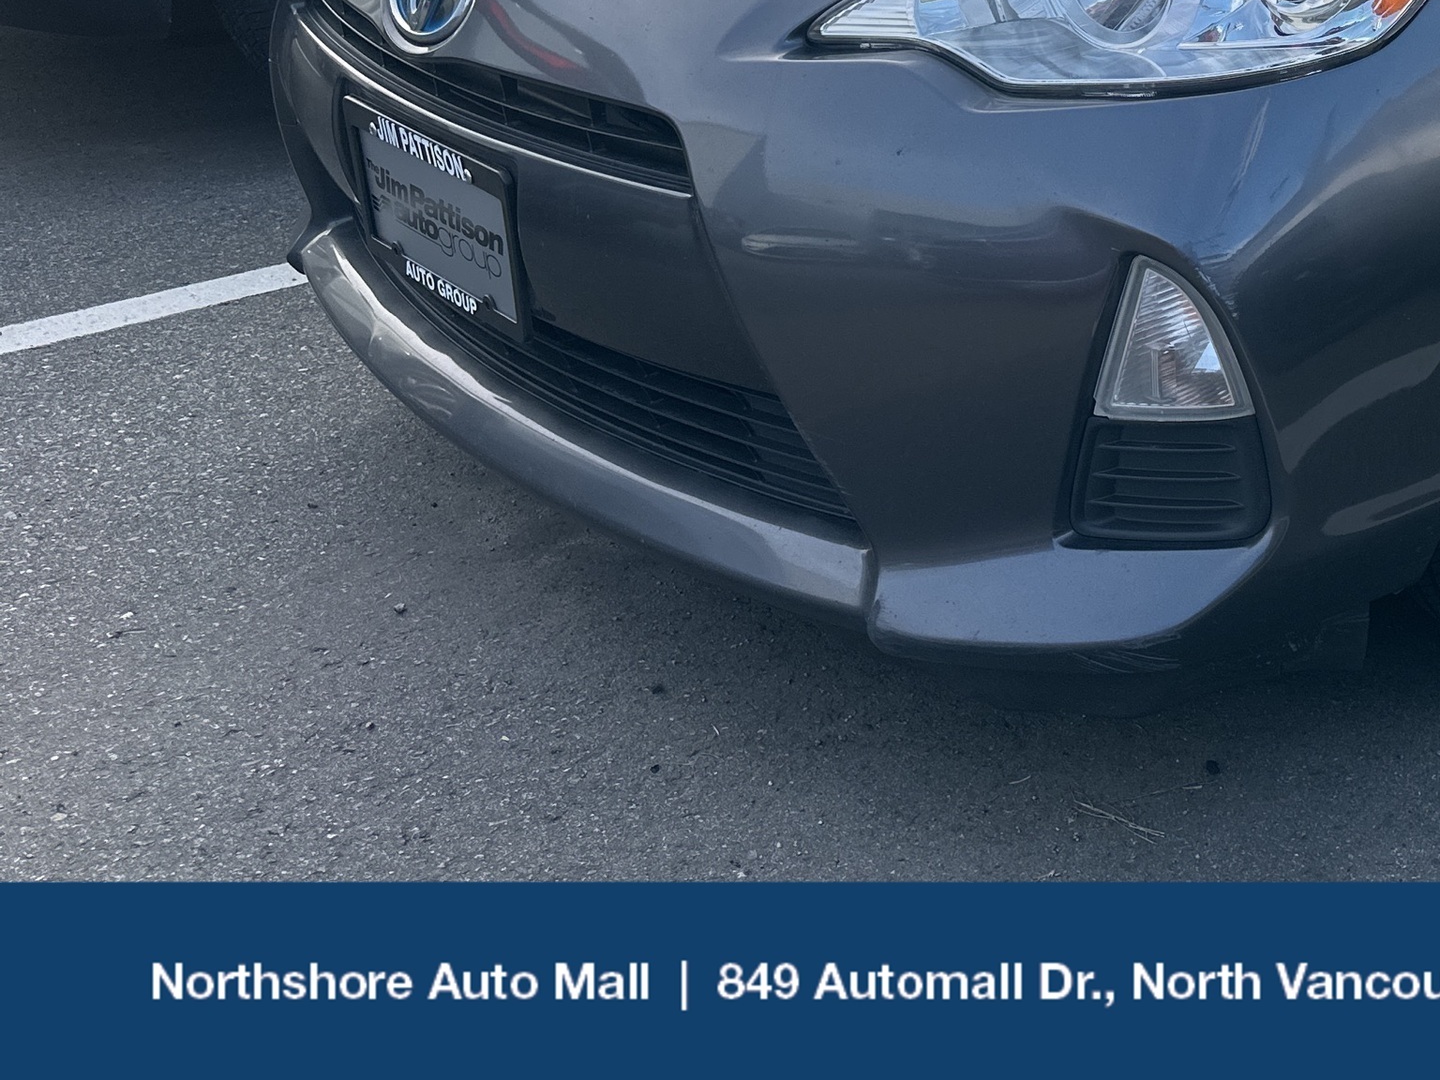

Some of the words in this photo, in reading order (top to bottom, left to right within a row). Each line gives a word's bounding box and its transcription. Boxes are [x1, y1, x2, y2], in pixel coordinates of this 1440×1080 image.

[366, 157, 380, 175] The
[377, 115, 400, 149] JIM
[399, 126, 467, 182] PATTISON
[375, 166, 409, 201] Jim
[409, 183, 504, 257] Pattison
[406, 260, 435, 291] AUTO
[437, 279, 478, 316] GROUP
